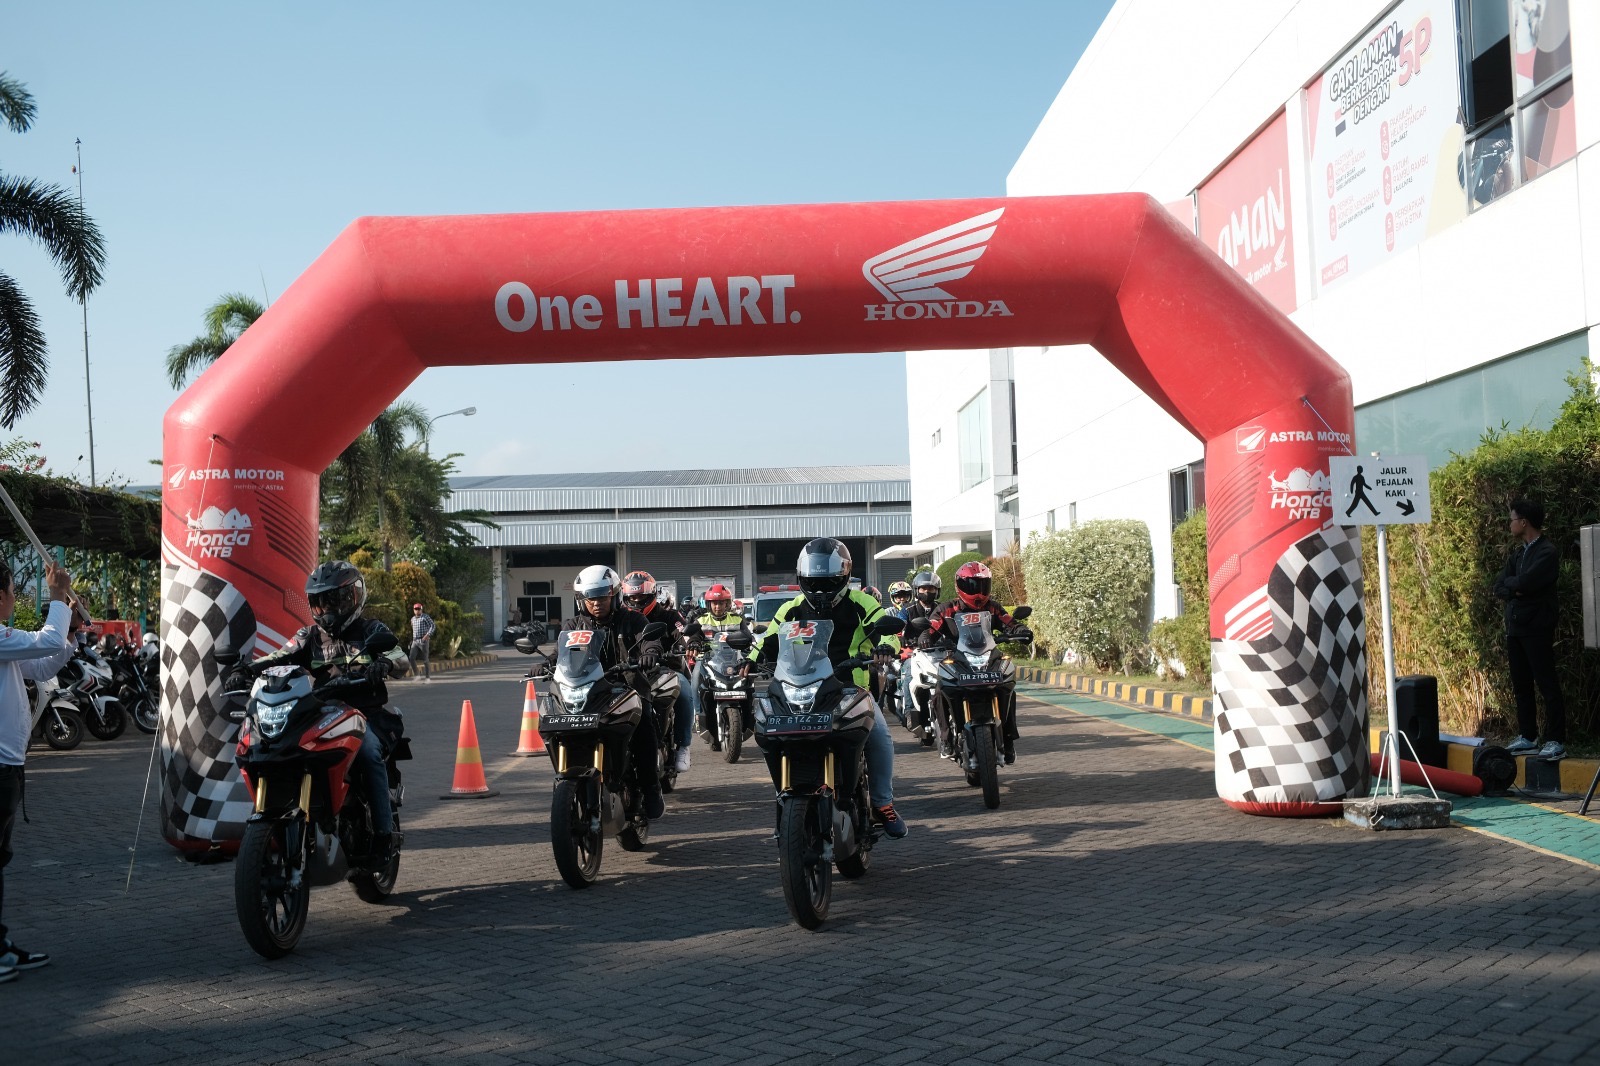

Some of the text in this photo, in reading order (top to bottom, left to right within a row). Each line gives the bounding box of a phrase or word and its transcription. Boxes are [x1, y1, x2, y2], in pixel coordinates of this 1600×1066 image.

[1399, 17, 1432, 87] 5P
[1330, 21, 1398, 102] CARI AMAN
[1340, 54, 1397, 116] BERKENDARA
[1354, 80, 1391, 125] DENGAN
[494, 274, 802, 333] One HEART.
[863, 299, 1015, 321] HONDA
[1269, 431, 1351, 444] ASTRA MOTOR
[189, 468, 285, 481] ASTRA MOTOR
[1380, 467, 1407, 475] JALUR
[1376, 478, 1414, 487] PEJALAN
[1385, 489, 1406, 498] KAKI
[1288, 507, 1321, 520] NTB
[186, 531, 250, 548] Honda
[200, 546, 233, 558] NTB
[566, 630, 593, 647] 35
[769, 716, 781, 725] DR
